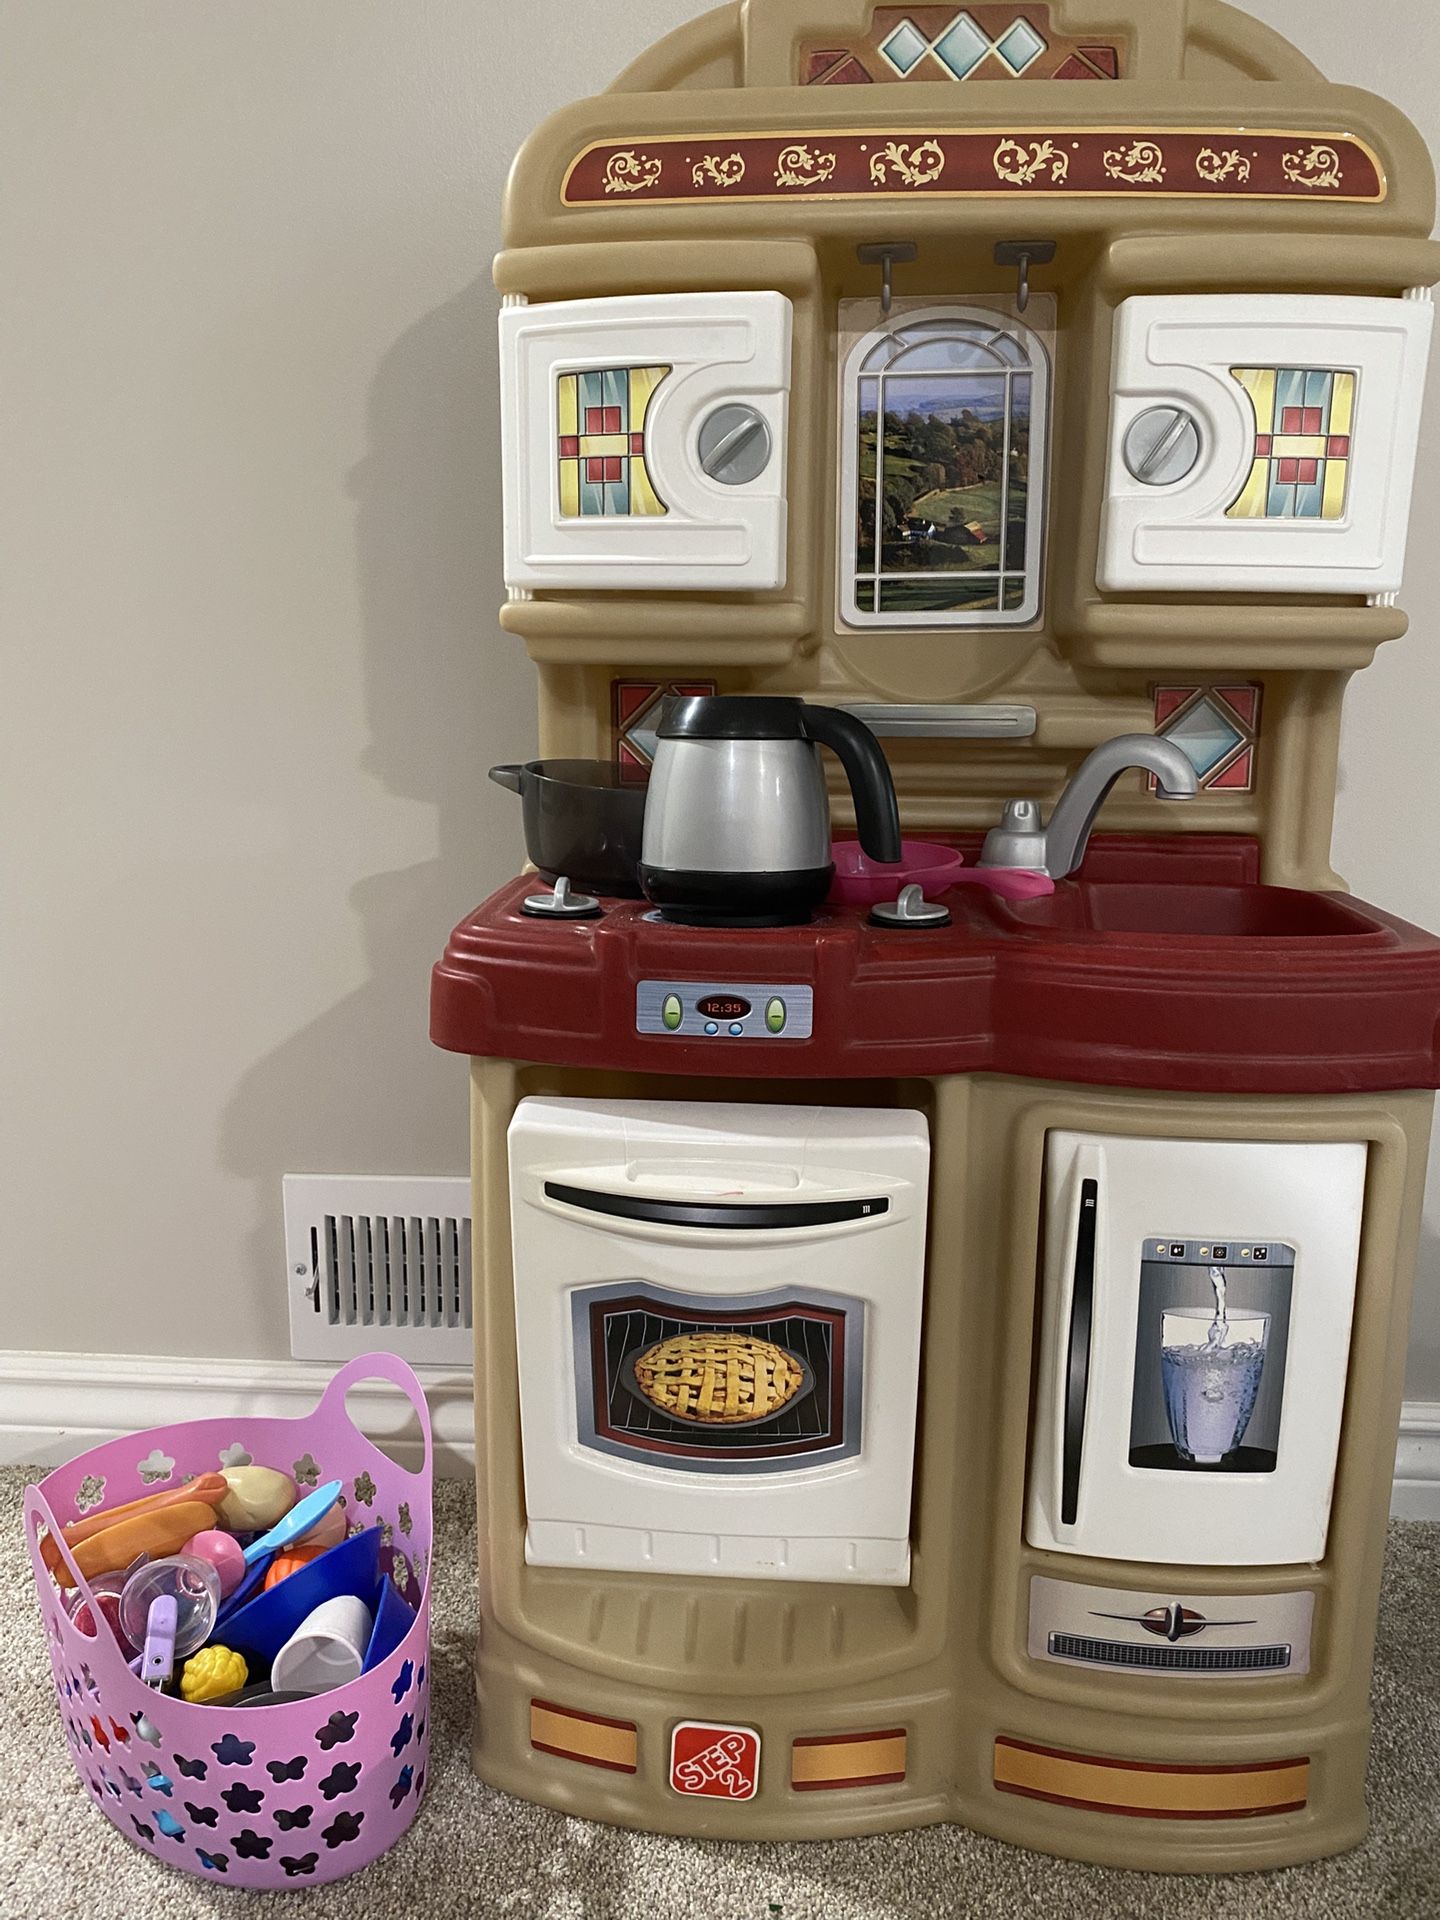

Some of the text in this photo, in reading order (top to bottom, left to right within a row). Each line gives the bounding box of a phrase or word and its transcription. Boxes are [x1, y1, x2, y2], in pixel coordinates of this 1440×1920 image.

[706, 1002, 742, 1014] 12:35
[675, 1733, 746, 1790] STEP
[719, 1767, 752, 1796] 2
